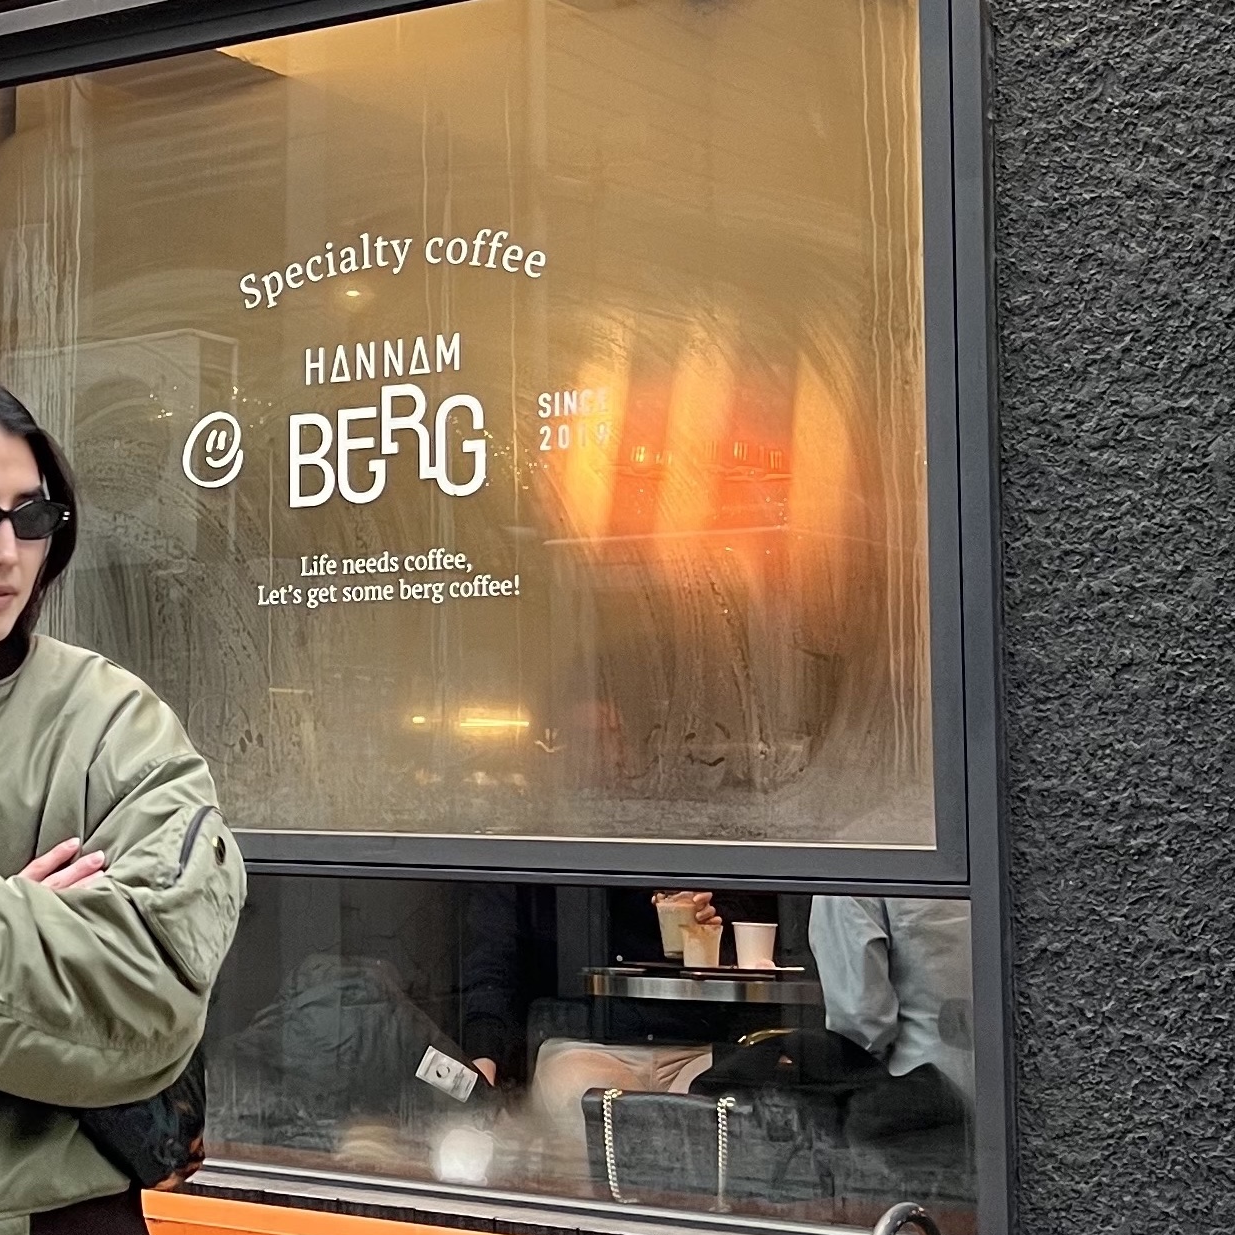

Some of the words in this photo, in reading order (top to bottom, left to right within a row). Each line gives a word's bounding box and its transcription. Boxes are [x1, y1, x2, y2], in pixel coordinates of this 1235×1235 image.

[239, 232, 413, 309] Specialty
[425, 228, 547, 279] coffee
[305, 332, 461, 386] HANNAM
[288, 382, 488, 509] BERG
[300, 553, 338, 577] Life
[342, 551, 400, 575] needs
[404, 547, 473, 573] coffee,
[306, 586, 339, 609] get
[342, 585, 395, 602] some
[398, 578, 446, 604] berg
[449, 574, 520, 598] coffee!
